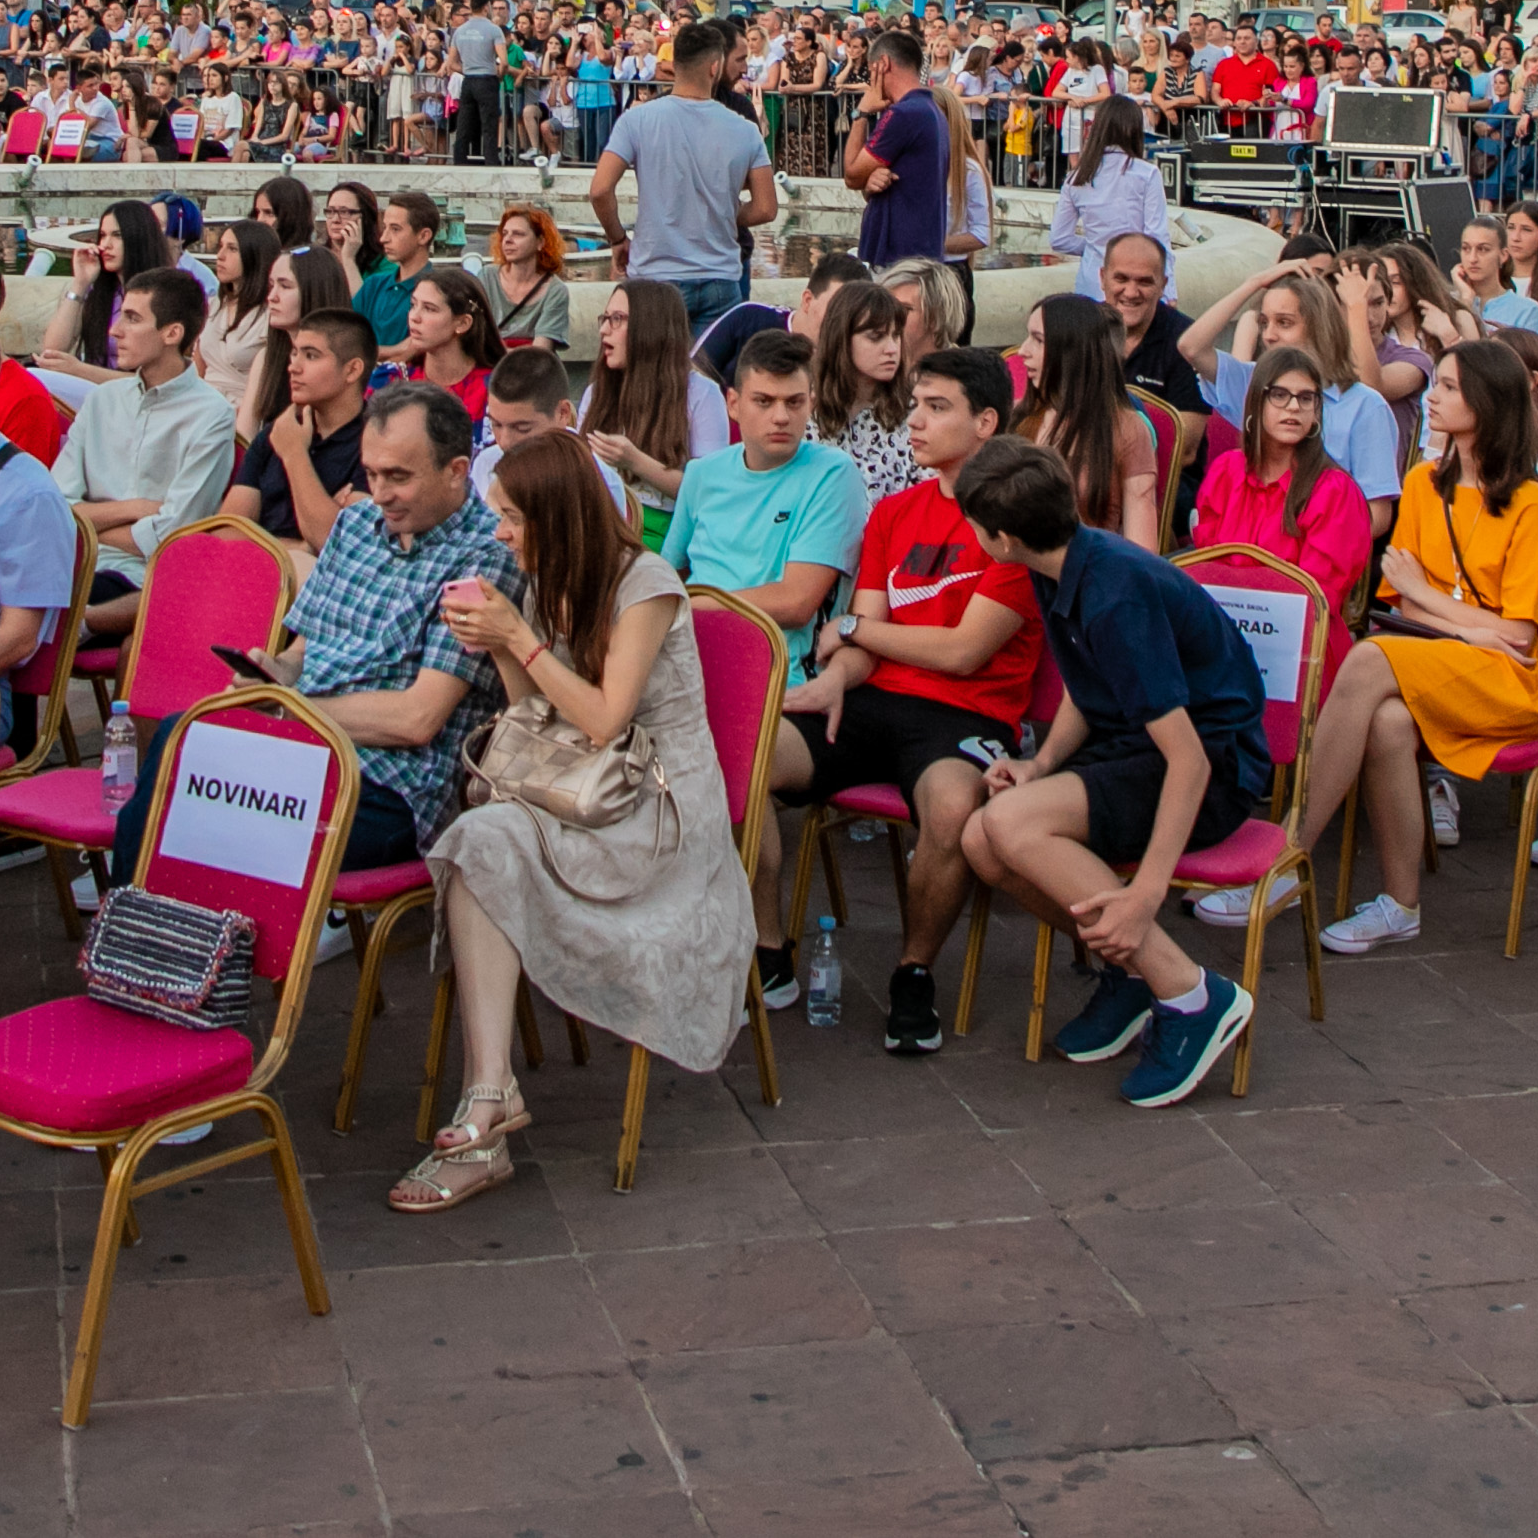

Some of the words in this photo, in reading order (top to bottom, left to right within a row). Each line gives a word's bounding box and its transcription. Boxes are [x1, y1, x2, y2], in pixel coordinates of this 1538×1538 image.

[900, 543, 966, 578] NIKE
[1235, 619, 1280, 636] RAD-
[187, 773, 308, 822] NOVINARI
